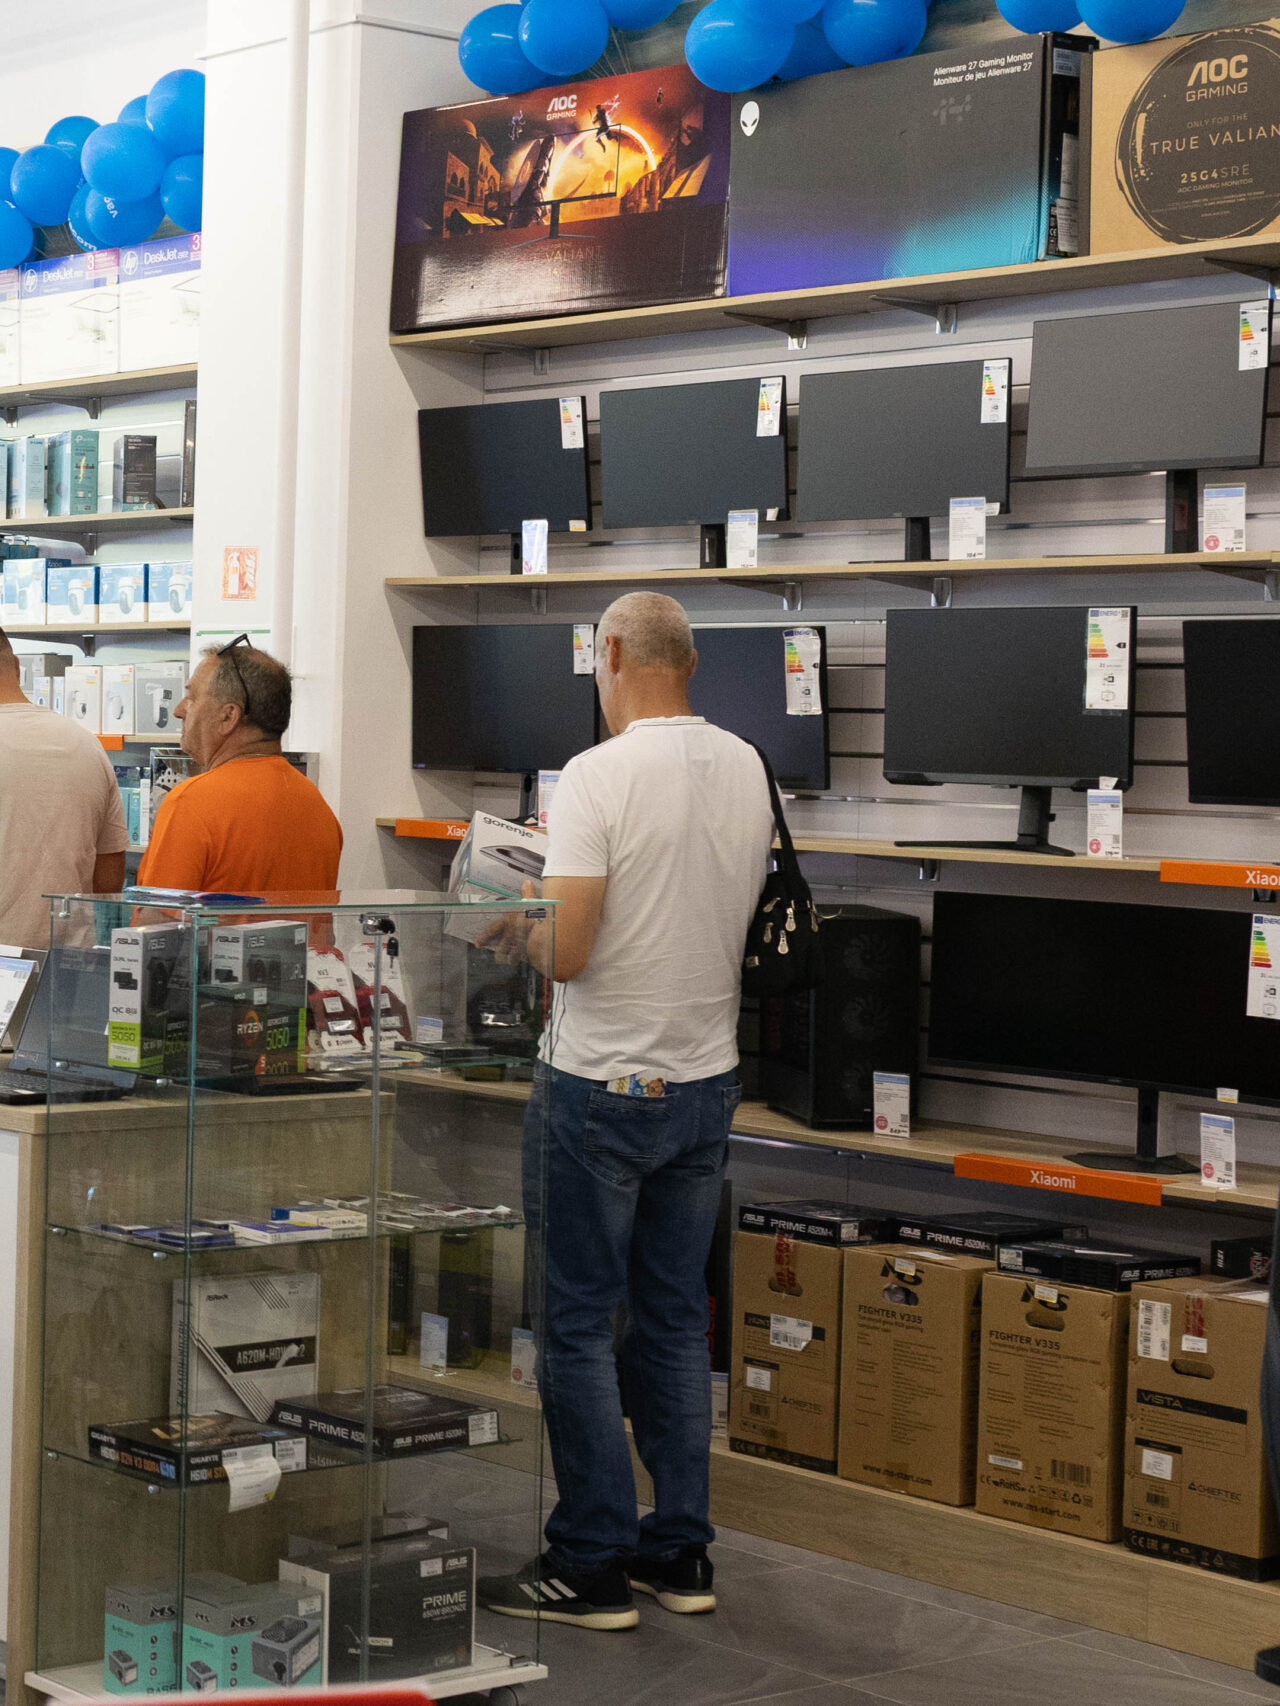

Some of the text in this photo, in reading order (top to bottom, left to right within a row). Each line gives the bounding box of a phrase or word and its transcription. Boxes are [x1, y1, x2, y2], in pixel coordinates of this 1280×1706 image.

[934, 52, 1034, 76] Alienware 27 Gaming Monitor
[1186, 54, 1248, 87] AOC
[933, 61, 1033, 86] Moniteur de jeu Alienware 27
[1186, 82, 1248, 102] GAMING
[548, 94, 577, 112] AOC
[546, 110, 577, 121] GAMING
[1187, 119, 1210, 129] ONLY
[1232, 112, 1249, 122] THE
[1150, 136, 1200, 155] TRUE
[1181, 164, 1250, 184] 25G4SRE
[143, 249, 177, 265] DeskJet
[483, 815, 534, 839] gorenje
[114, 938, 140, 946] ASUS
[216, 936, 240, 944] ASUS
[111, 1031, 136, 1042] 5050
[237, 1021, 263, 1035] RYZEN
[1029, 1170, 1076, 1190] Xiaomi
[743, 1213, 765, 1222] ASUS
[770, 1219, 807, 1233] PRIME
[900, 1226, 921, 1236] ASUS
[927, 1232, 964, 1246] PRIME
[1121, 1269, 1175, 1279] ASUS PRIME
[858, 1304, 923, 1324] FIGHTER V335
[989, 1330, 1061, 1350] FIGHTER V335
[278, 1411, 302, 1422] ASUS
[309, 1420, 350, 1441] PRIME
[394, 1437, 412, 1448] ASUS
[415, 1431, 444, 1444] PRIME
[190, 1456, 219, 1465] GIGABYTE
[445, 1556, 468, 1568] ASUS
[422, 1590, 467, 1610] PRIME
[441, 1603, 467, 1615] BRONZE
[150, 1606, 177, 1618] MS
[231, 1615, 257, 1628] MS
